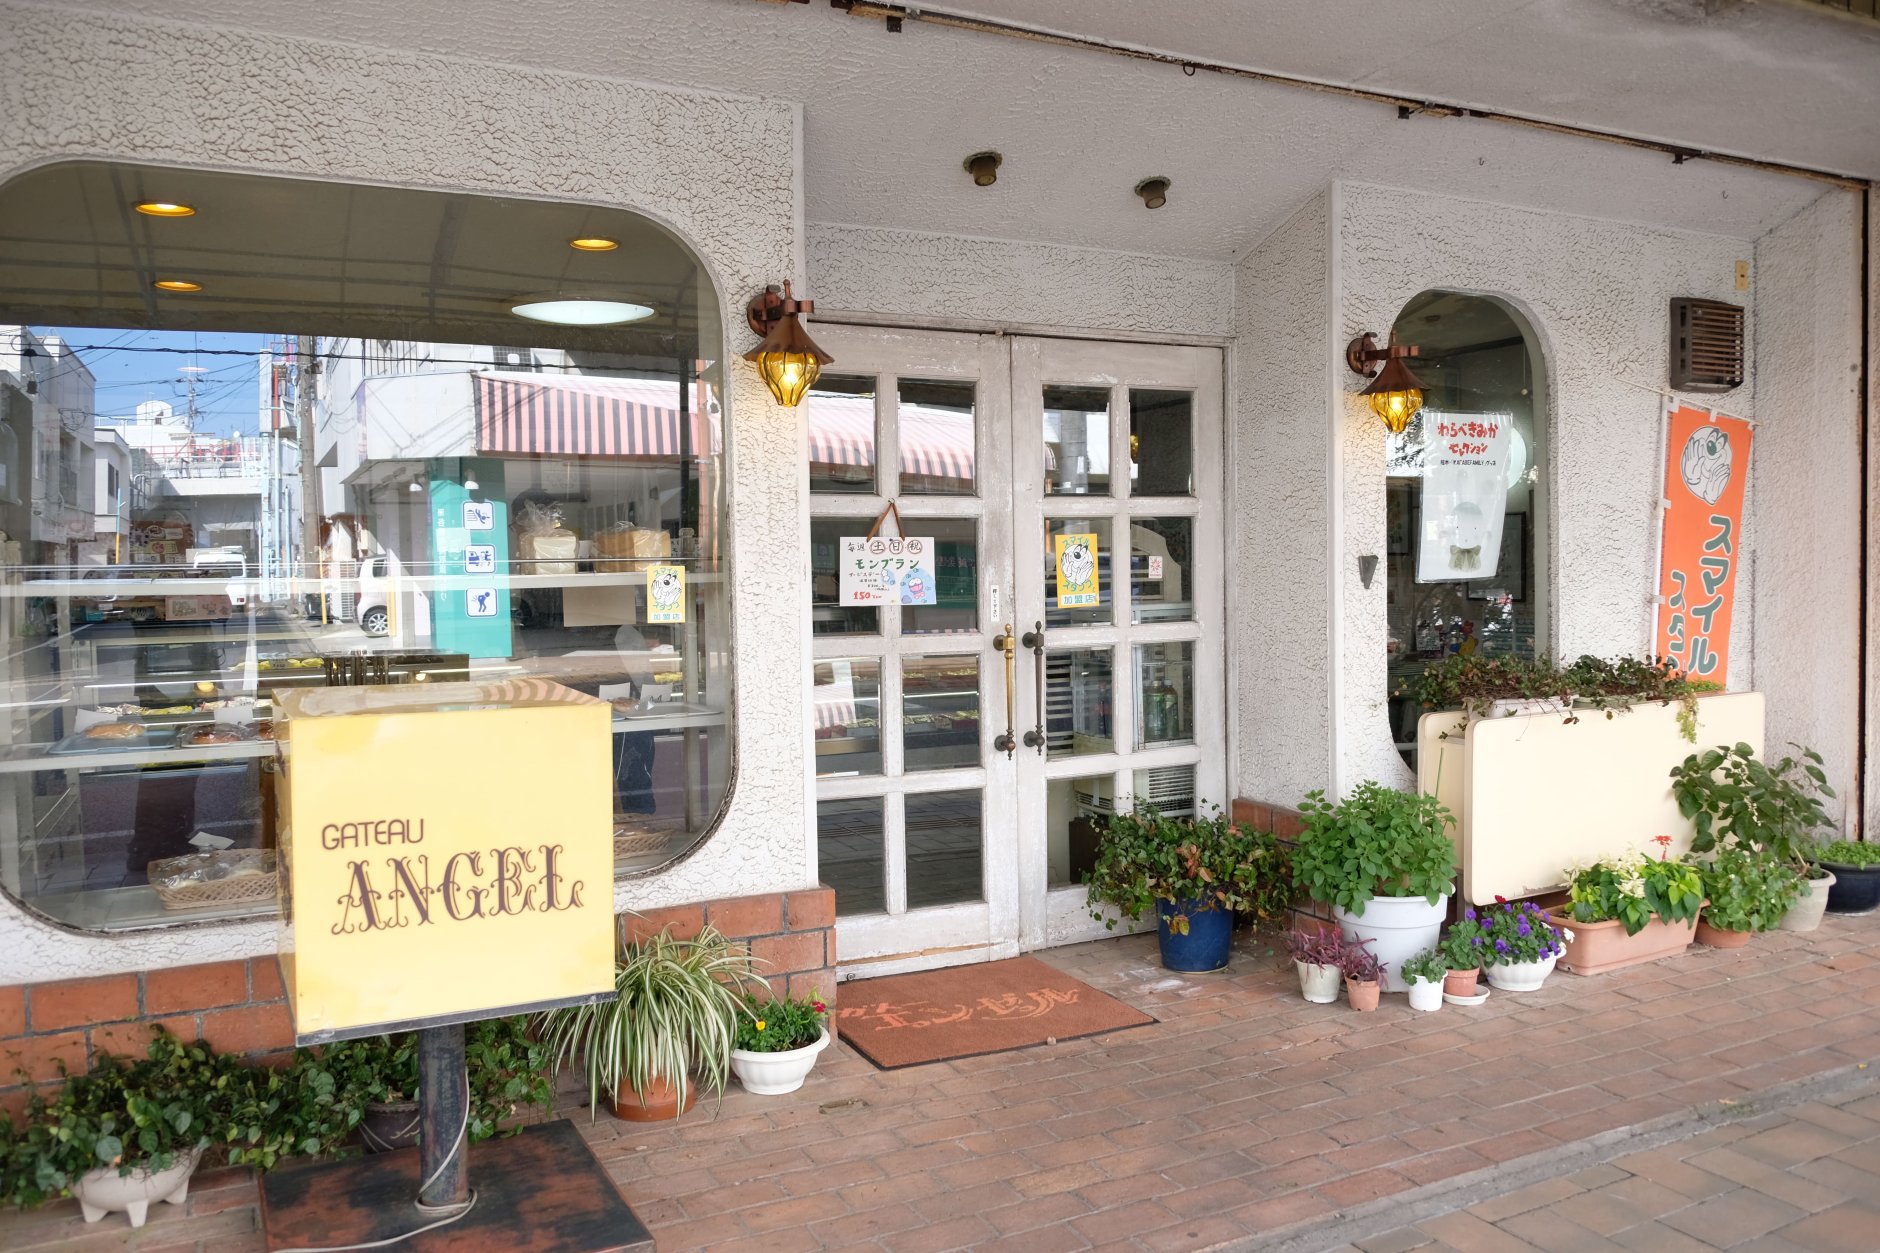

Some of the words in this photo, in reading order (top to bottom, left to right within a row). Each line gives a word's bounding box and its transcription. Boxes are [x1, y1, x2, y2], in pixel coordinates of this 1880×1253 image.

[1437, 421, 1499, 439] わらべきみか
[1448, 442, 1489, 457] セレクション
[1062, 536, 1090, 548] スマイル
[855, 557, 920, 570] モンブラン
[853, 591, 871, 600] 150
[1063, 594, 1095, 605] 加盟店
[1687, 515, 1733, 675] スマイル
[653, 613, 681, 621] 加盟店
[321, 818, 425, 851] GATEAU
[331, 844, 585, 936] ANGEL
[861, 987, 1080, 1032] エンゼル
